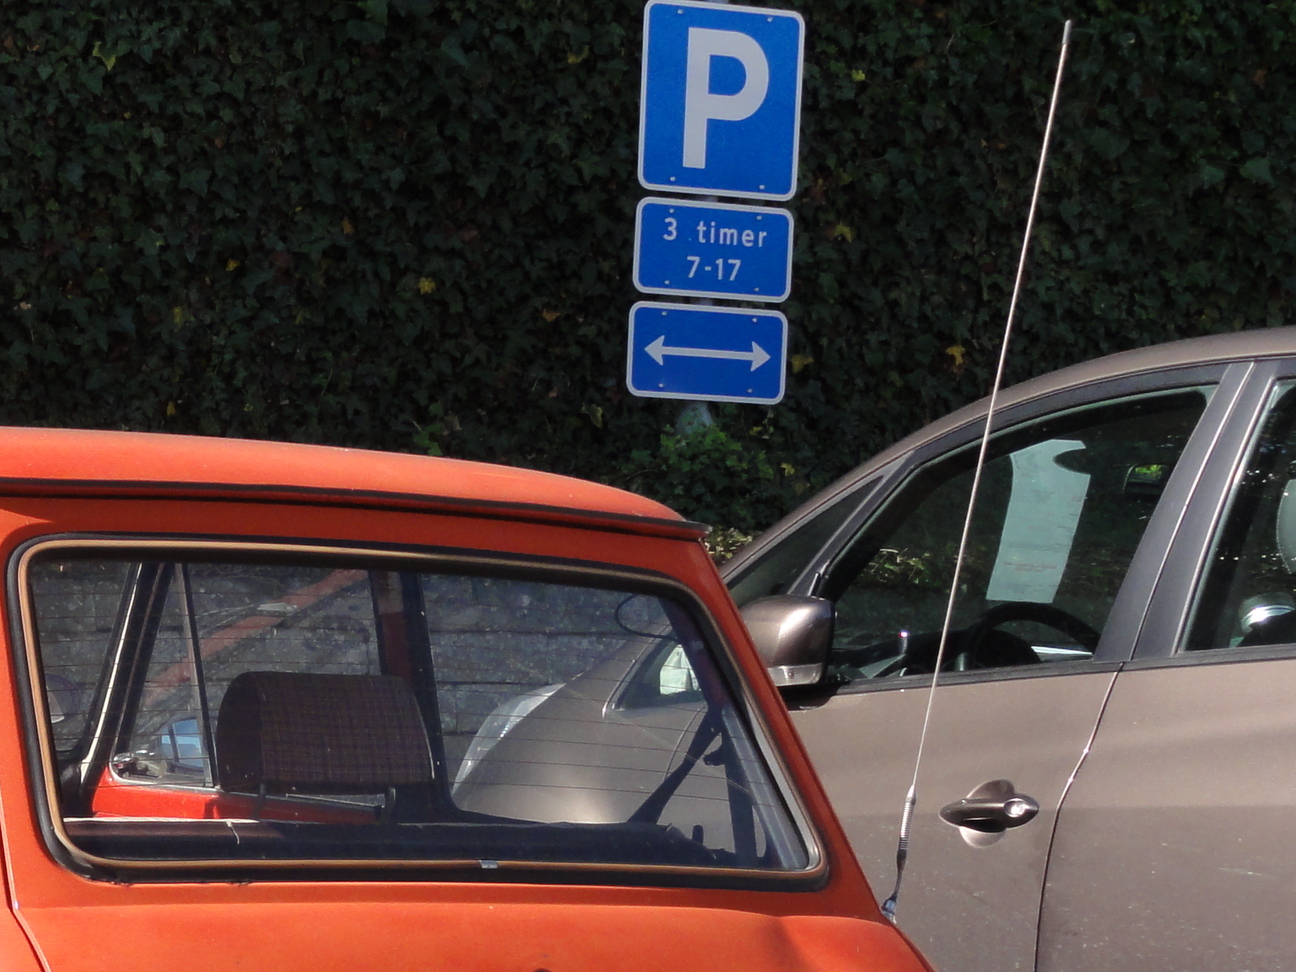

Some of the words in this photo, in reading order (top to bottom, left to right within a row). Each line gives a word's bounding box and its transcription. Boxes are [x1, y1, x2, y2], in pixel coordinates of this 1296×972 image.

[682, 27, 770, 169] P
[663, 217, 677, 242] 3
[697, 220, 768, 249] timer
[686, 255, 742, 282] 7-17
